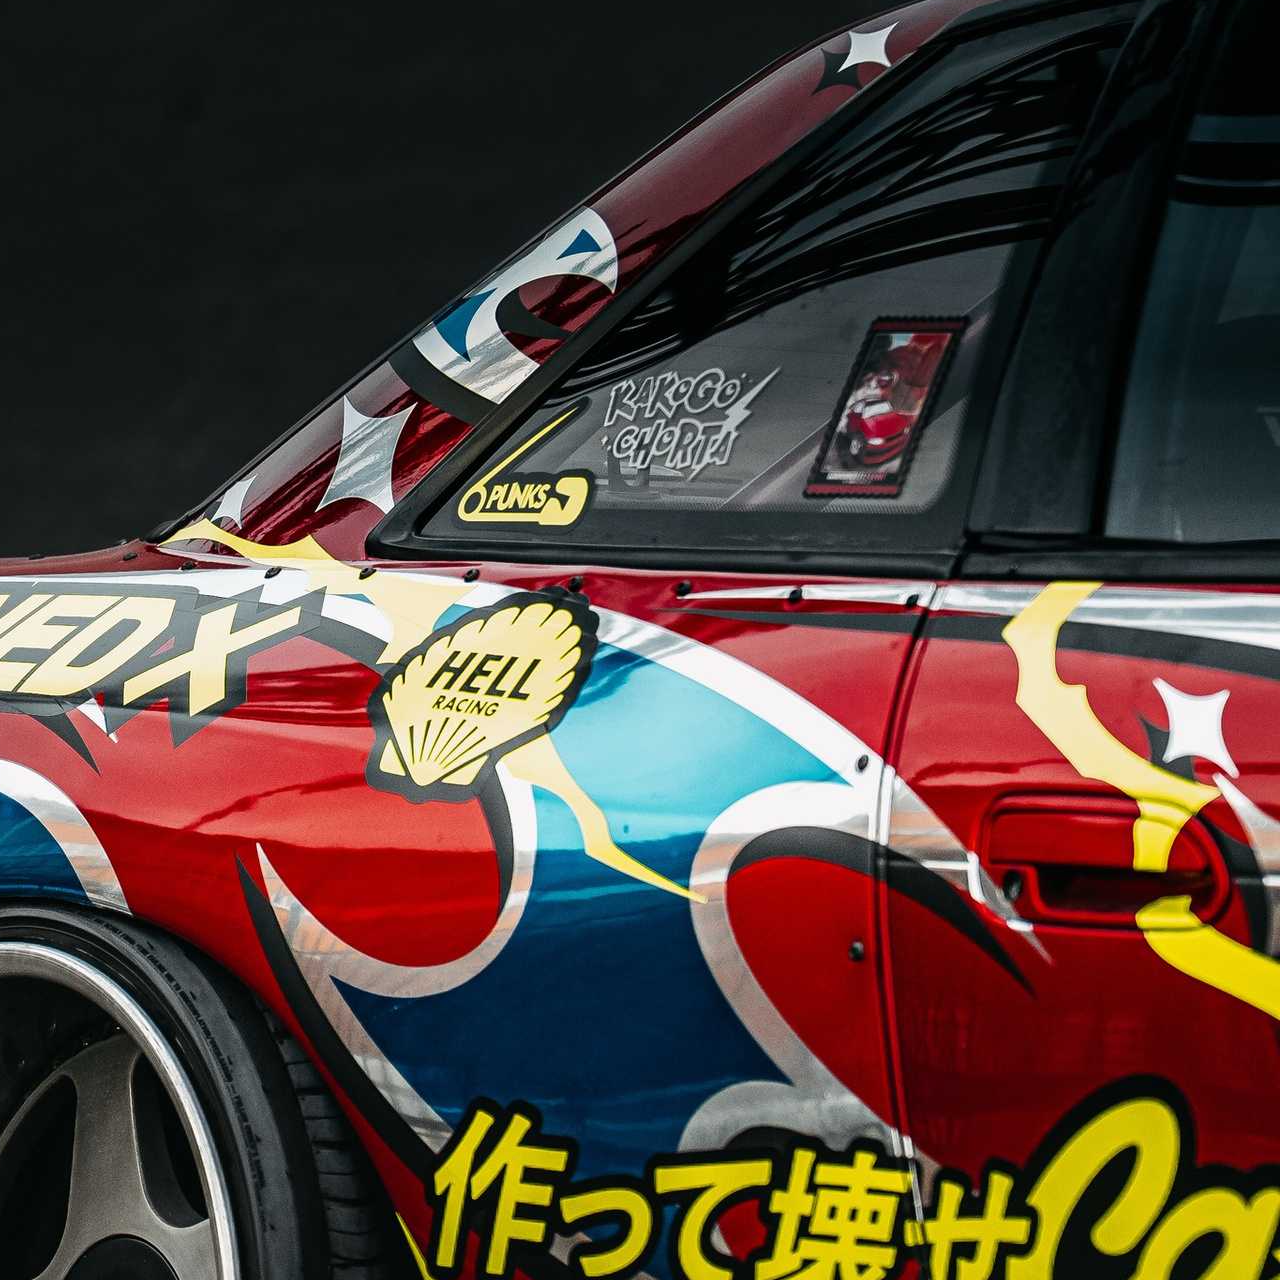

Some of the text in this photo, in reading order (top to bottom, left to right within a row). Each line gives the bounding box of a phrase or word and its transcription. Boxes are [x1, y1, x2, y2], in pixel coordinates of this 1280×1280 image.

[603, 367, 742, 428] KAKOGO
[612, 418, 739, 471] CHORTA
[484, 481, 552, 512] PUNKS
[424, 649, 542, 701] HELL
[431, 694, 500, 717] RACING
